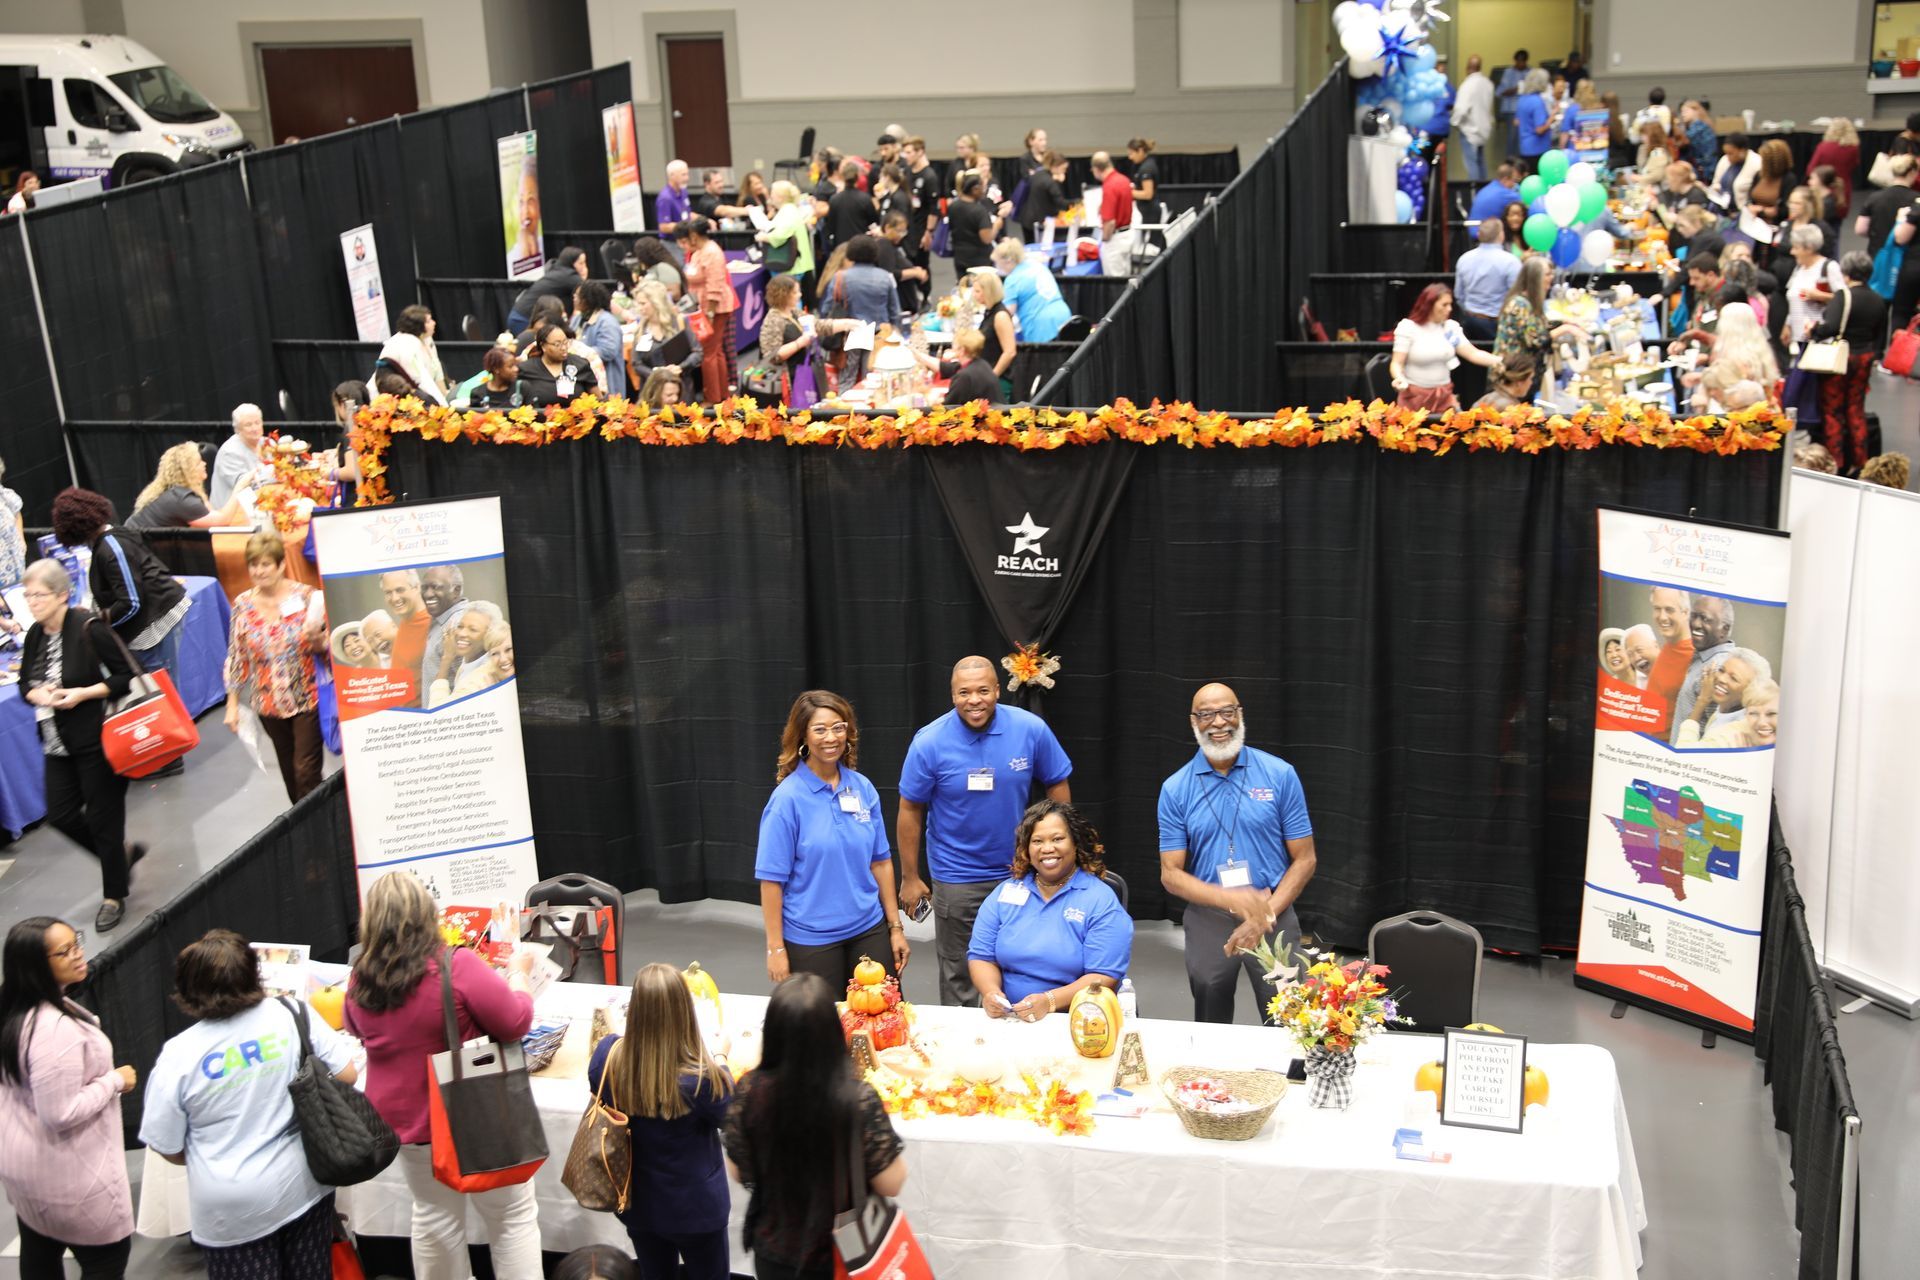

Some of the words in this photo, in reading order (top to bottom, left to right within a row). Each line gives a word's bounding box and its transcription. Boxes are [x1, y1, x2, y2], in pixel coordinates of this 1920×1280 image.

[411, 511, 448, 521] Agency
[417, 523, 448, 535] Aging
[1664, 524, 1687, 536] Area
[1694, 529, 1732, 546] Agency
[384, 543, 395, 554] of
[398, 540, 419, 550] East
[422, 538, 449, 547] Texas
[1678, 544, 1690, 552] on
[1698, 545, 1729, 561] Aging
[998, 555, 1058, 571] REACH
[1662, 558, 1673, 568] of
[1675, 558, 1697, 569] East
[1701, 562, 1728, 576] Texas
[348, 675, 387, 687] Dedicated
[1604, 688, 1641, 703] Dedicated
[365, 734, 394, 744] provides
[407, 727, 438, 738] following
[439, 724, 464, 733] services
[465, 720, 490, 729] directly
[381, 725, 396, 733] Area
[398, 722, 422, 731] Agency
[433, 718, 452, 726] Aging
[361, 744, 382, 753] clients
[383, 742, 402, 751] living
[423, 734, 456, 743] 14-county
[457, 729, 487, 738] coverage
[419, 751, 444, 760] Referral
[459, 745, 492, 754] Assistance
[378, 769, 404, 779] Benefits
[461, 757, 494, 766] Assistance
[1632, 751, 1654, 761] Agency
[1664, 758, 1681, 768] Aging
[1689, 764, 1701, 772] East
[1703, 768, 1719, 777] Texas
[1720, 774, 1748, 784] provides
[394, 778, 418, 787] Nursing
[440, 769, 481, 780] Ombudsman
[1625, 760, 1645, 768] clients
[1645, 763, 1662, 773] living
[1681, 772, 1711, 785] 14-county
[1712, 781, 1740, 793] coverage
[397, 788, 425, 798] In-Home
[426, 784, 453, 792] Provider
[454, 780, 481, 789] Services
[394, 801, 418, 809] Respite
[430, 795, 451, 804] Family
[452, 790, 486, 800] Caregivers
[386, 814, 405, 822] Minor
[396, 821, 431, 831] Emergency
[432, 816, 462, 825] Response
[463, 811, 489, 820] Services
[379, 832, 427, 845] Transportation
[437, 826, 463, 834] Medical
[464, 819, 509, 831] Appointments
[404, 842, 435, 851] Delivered
[450, 834, 486, 844] Congregate
[1638, 969, 1689, 991] www.etcog.org
[202, 1033, 284, 1080] CARE
[1459, 1053, 1482, 1062] POUR
[1485, 1056, 1509, 1065] FROM
[1481, 1046, 1507, 1055] CAN'T
[1476, 1065, 1505, 1075] EMPTY
[1464, 1084, 1487, 1093] CARE
[1490, 1086, 1500, 1094] OF
[1482, 1076, 1503, 1085] TAKE
[1460, 1094, 1504, 1105] YOURSELF
